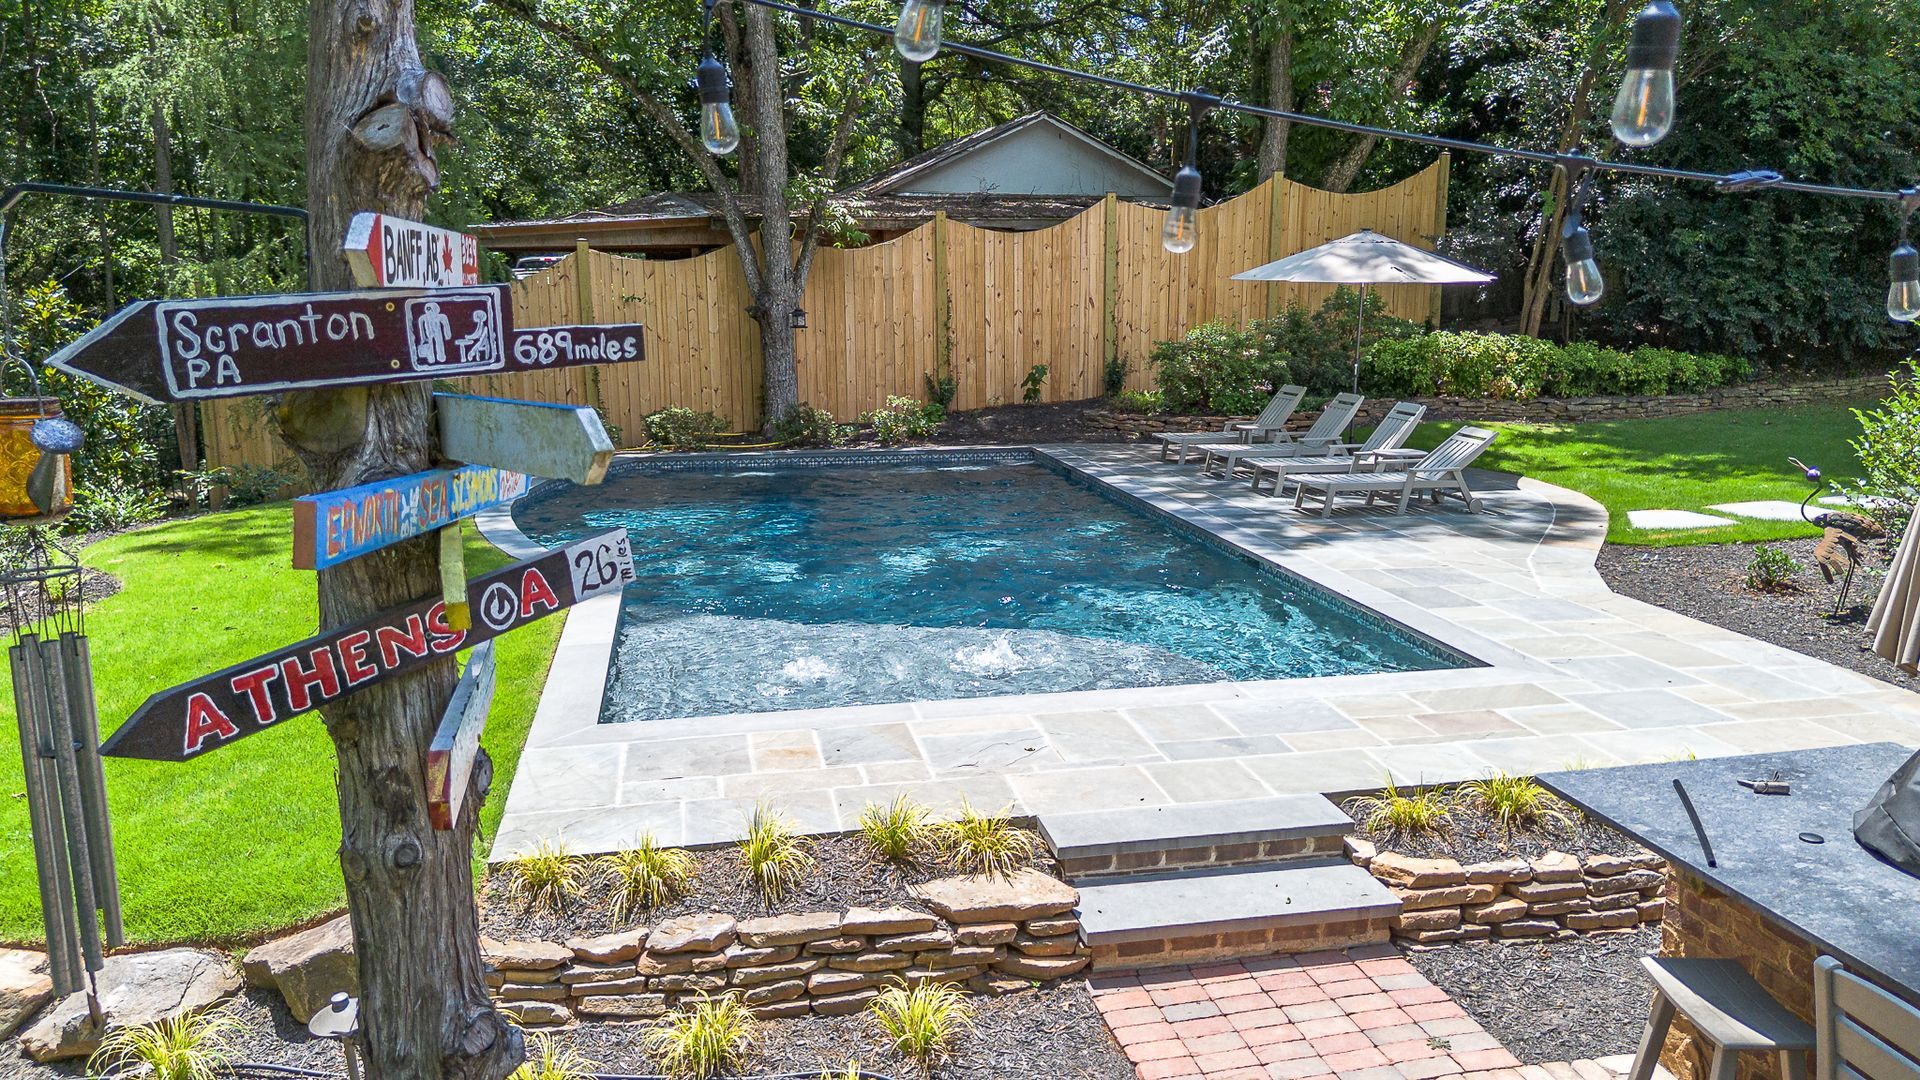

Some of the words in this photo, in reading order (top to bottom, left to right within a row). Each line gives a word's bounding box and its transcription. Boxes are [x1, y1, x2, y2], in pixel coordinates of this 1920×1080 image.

[174, 304, 375, 359] Scranton
[187, 354, 242, 388] PA
[327, 487, 400, 559] EPWORTH
[418, 479, 449, 529] SEA
[616, 537, 633, 583] miles
[184, 601, 467, 755] ATHENS
[574, 543, 618, 597] 26
